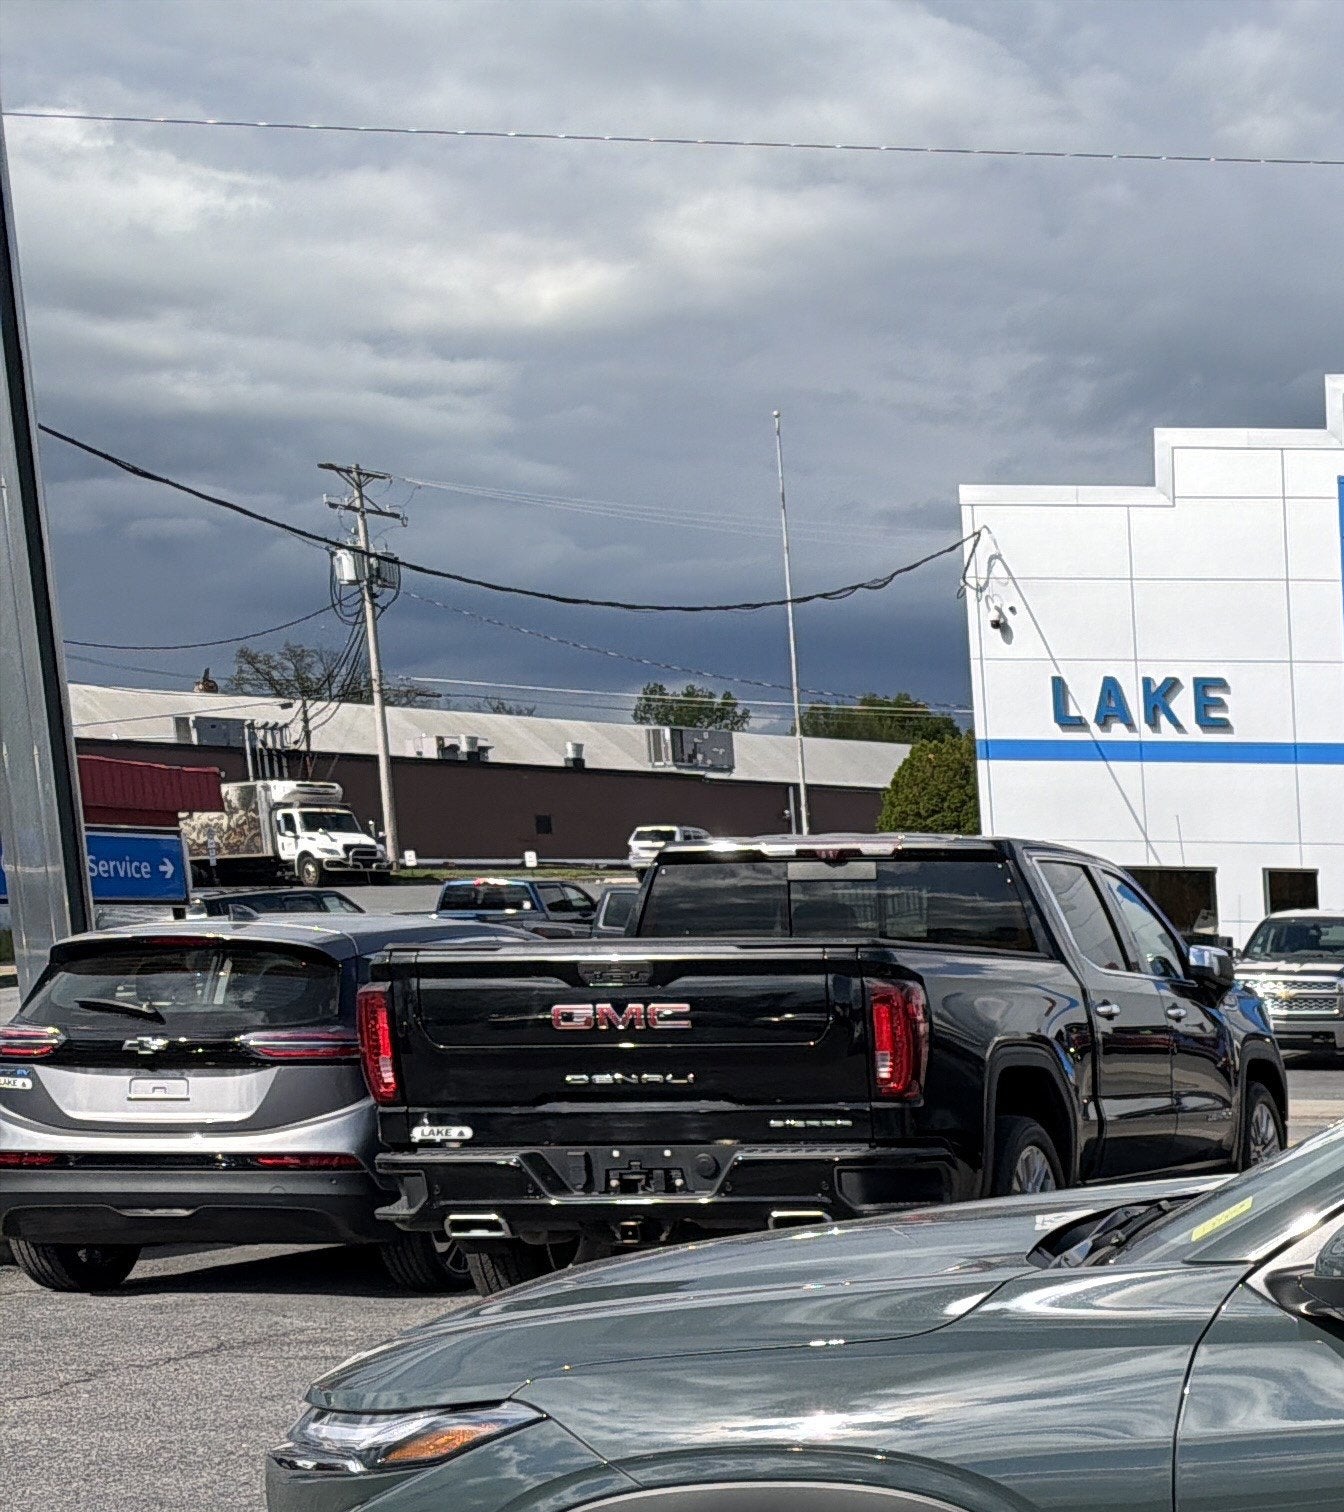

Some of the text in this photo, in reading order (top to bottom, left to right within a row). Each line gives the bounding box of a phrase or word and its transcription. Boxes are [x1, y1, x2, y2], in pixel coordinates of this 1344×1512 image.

[1051, 675, 1231, 730] LAKE
[88, 855, 151, 879] Service
[551, 1003, 692, 1029] GMC
[420, 1128, 453, 1137] LAKE
